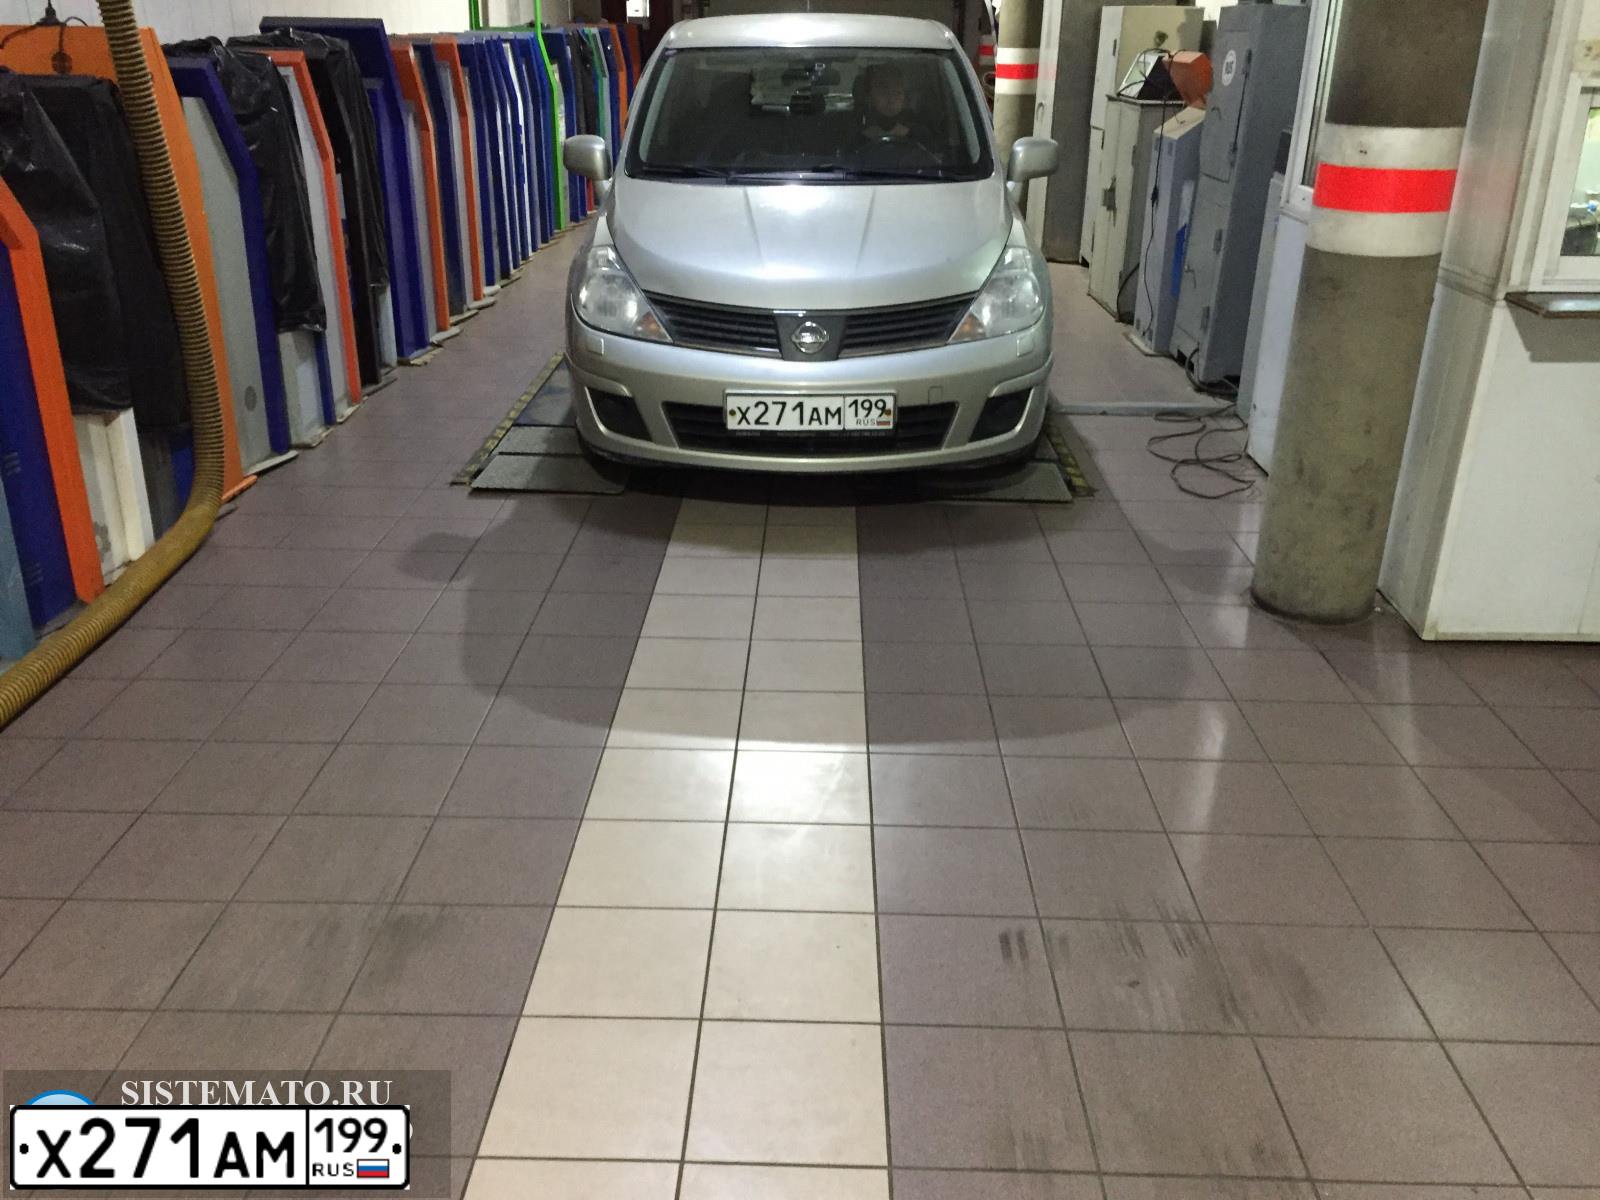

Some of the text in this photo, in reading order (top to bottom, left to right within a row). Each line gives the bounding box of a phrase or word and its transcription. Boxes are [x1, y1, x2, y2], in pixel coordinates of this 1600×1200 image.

[736, 399, 887, 426] X271AM 199
[856, 418, 876, 426] RUS
